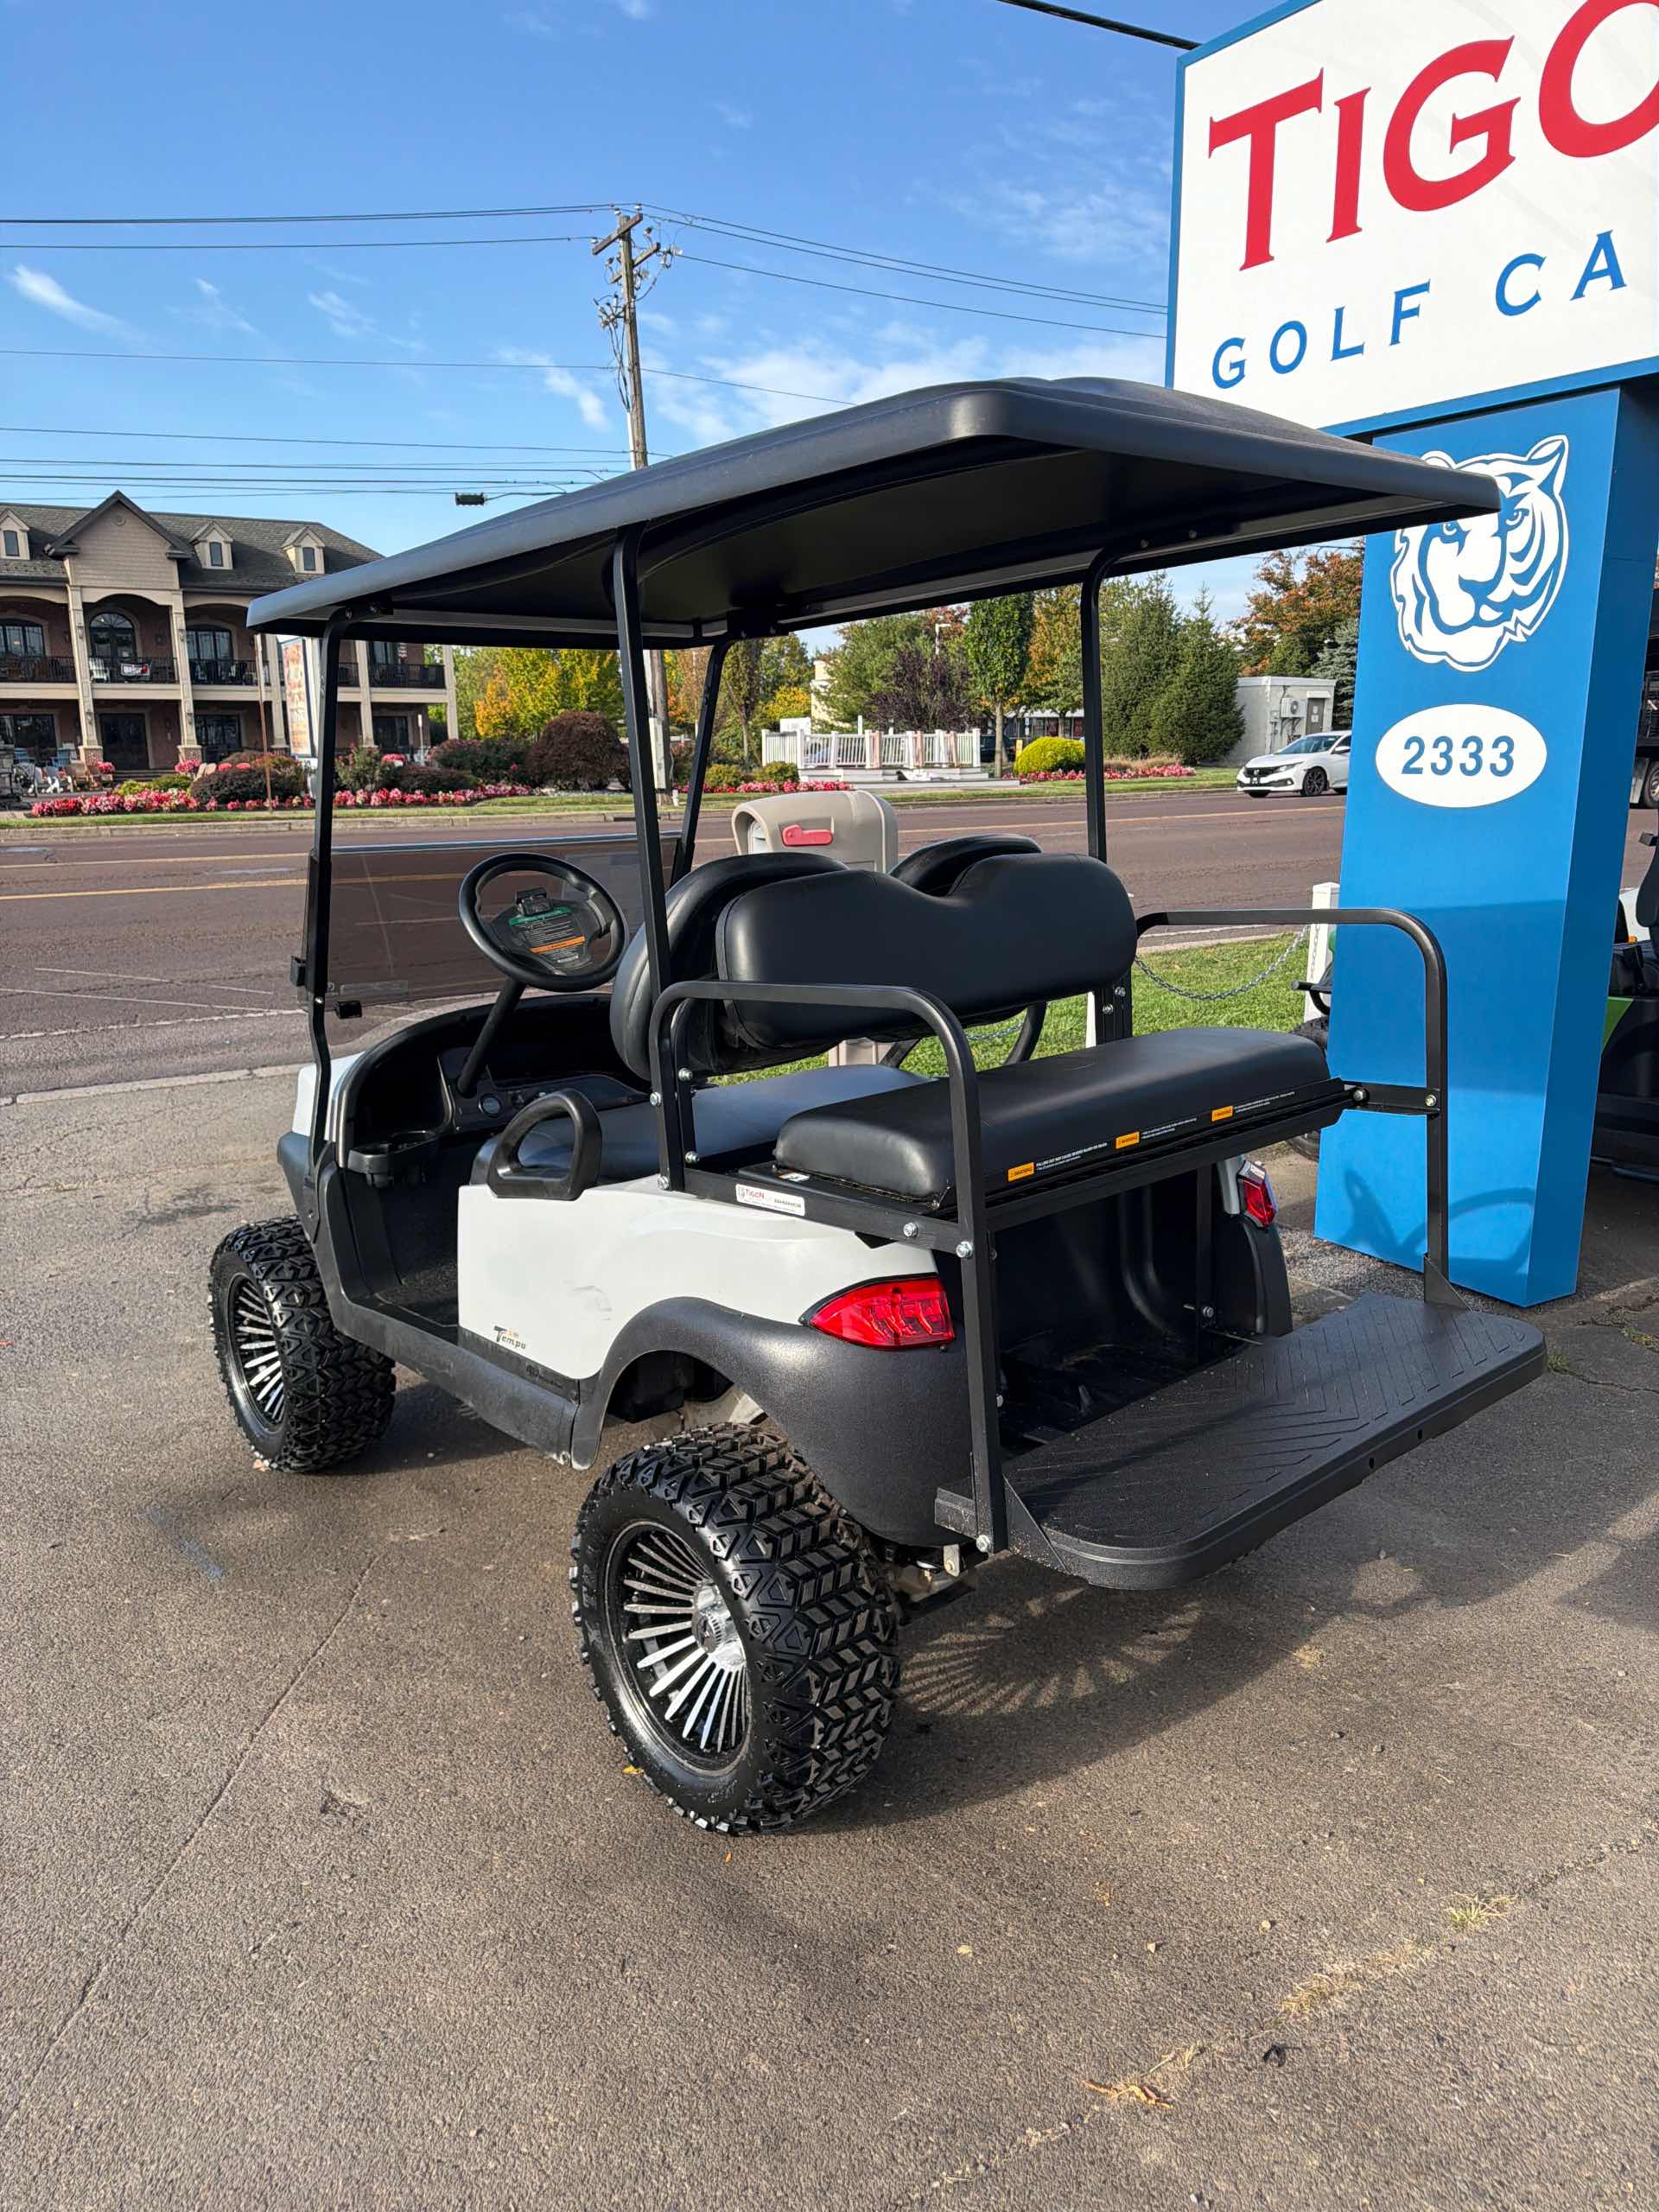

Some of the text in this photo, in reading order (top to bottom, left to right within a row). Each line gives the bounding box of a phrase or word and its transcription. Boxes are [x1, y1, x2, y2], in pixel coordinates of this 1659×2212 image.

[1211, 229, 1628, 390] GOLF CA
[1401, 734, 1516, 778] 2333
